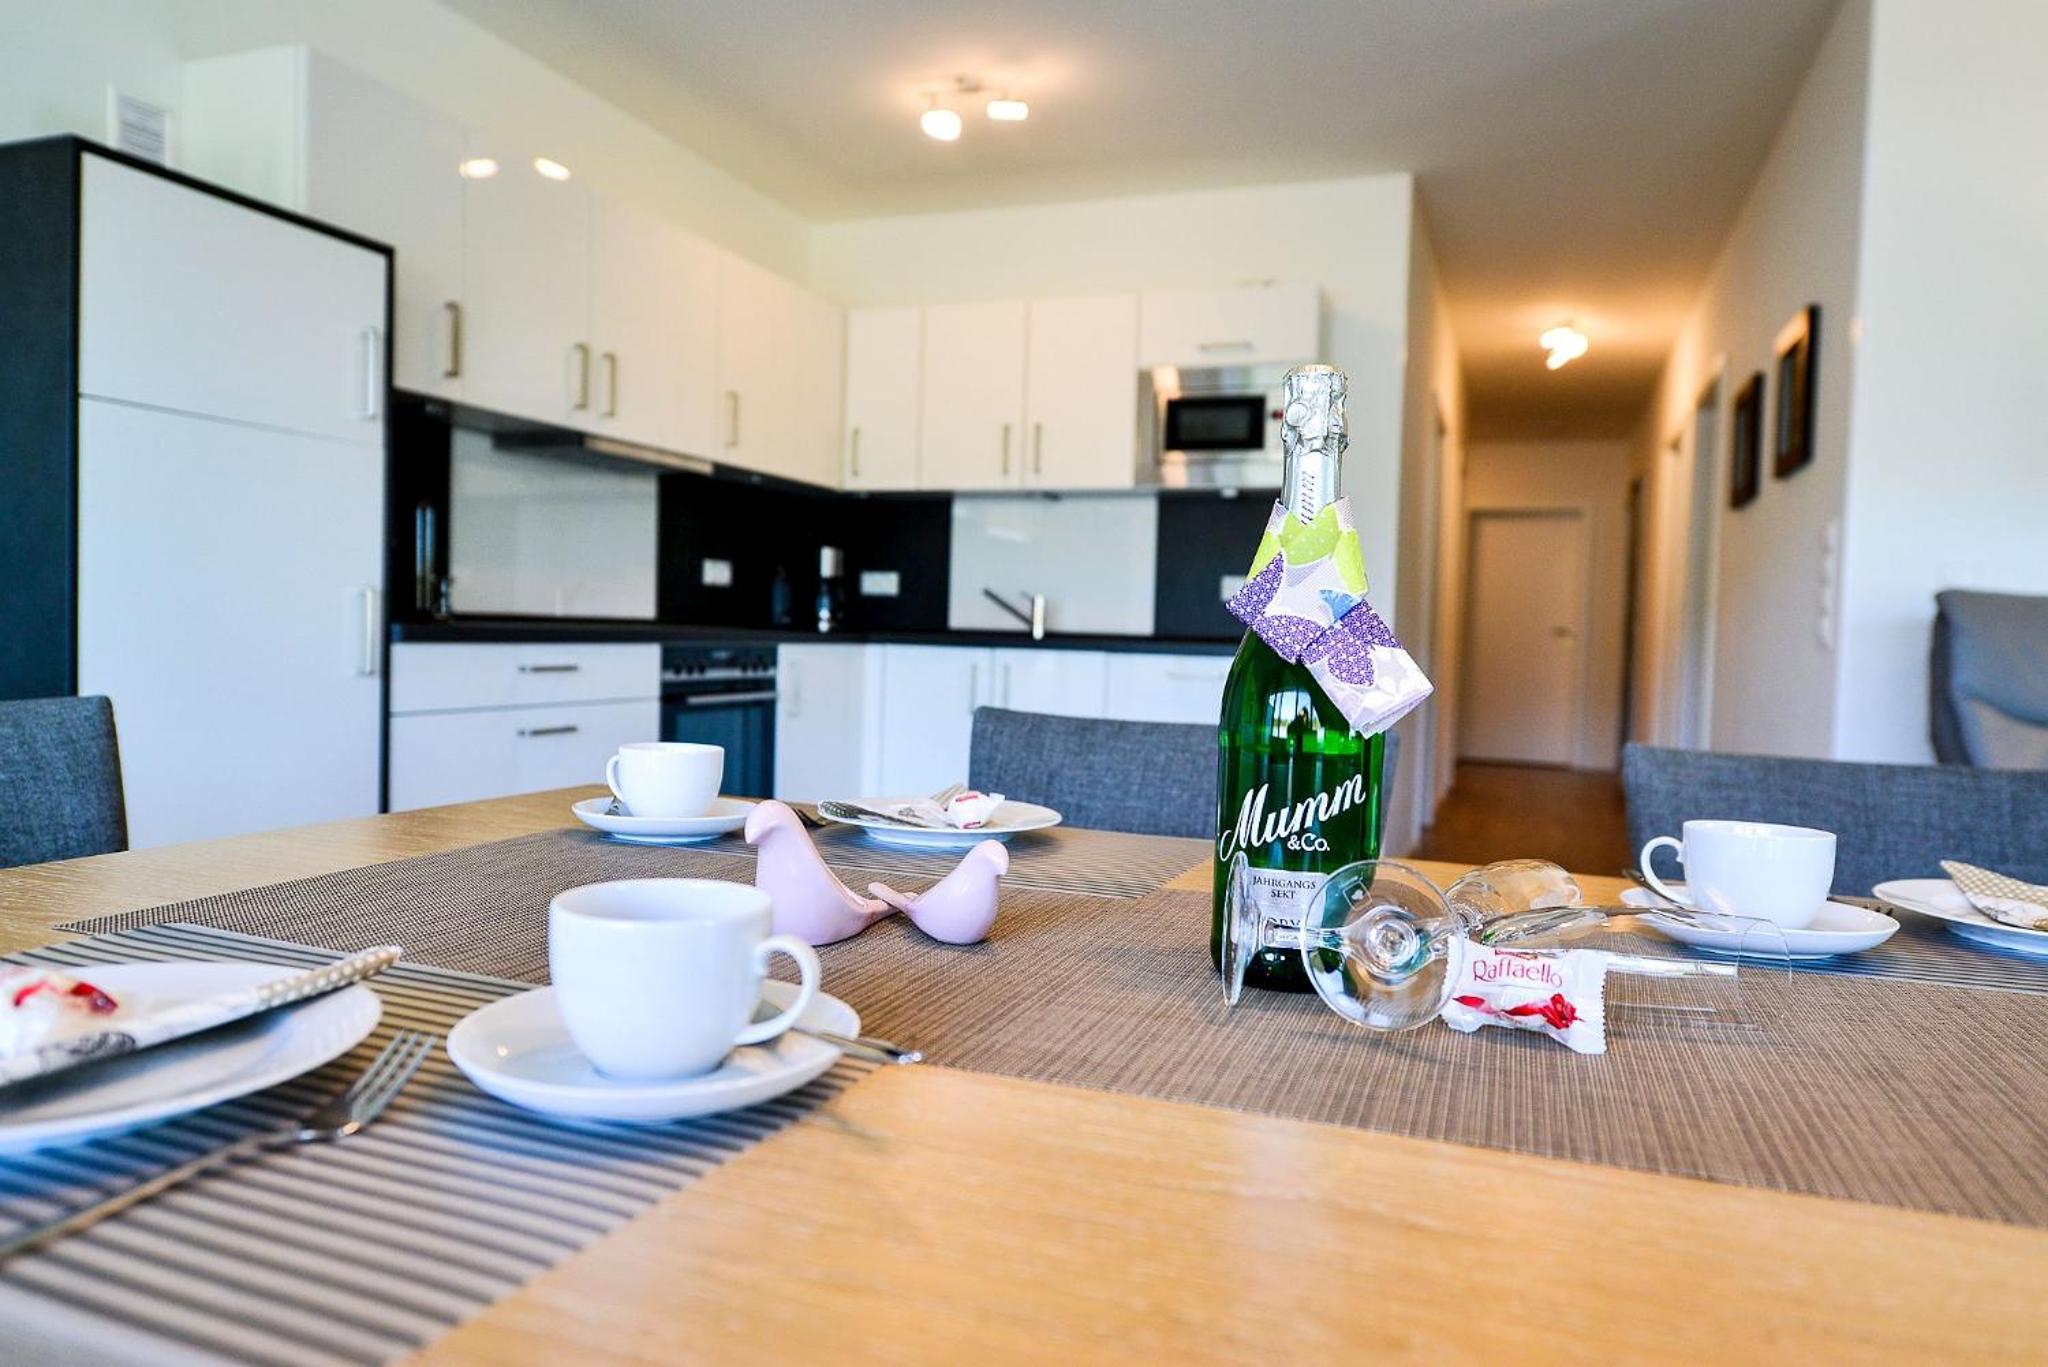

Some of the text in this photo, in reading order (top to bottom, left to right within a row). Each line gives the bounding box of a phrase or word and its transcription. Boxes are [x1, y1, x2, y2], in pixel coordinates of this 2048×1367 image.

[1219, 773, 1366, 862] Mumm
[1287, 832, 1331, 852] &Co.
[1252, 875, 1317, 890] JAHRGANGS
[1270, 889, 1296, 900] SEKT
[1472, 957, 1563, 989] Raffaello
